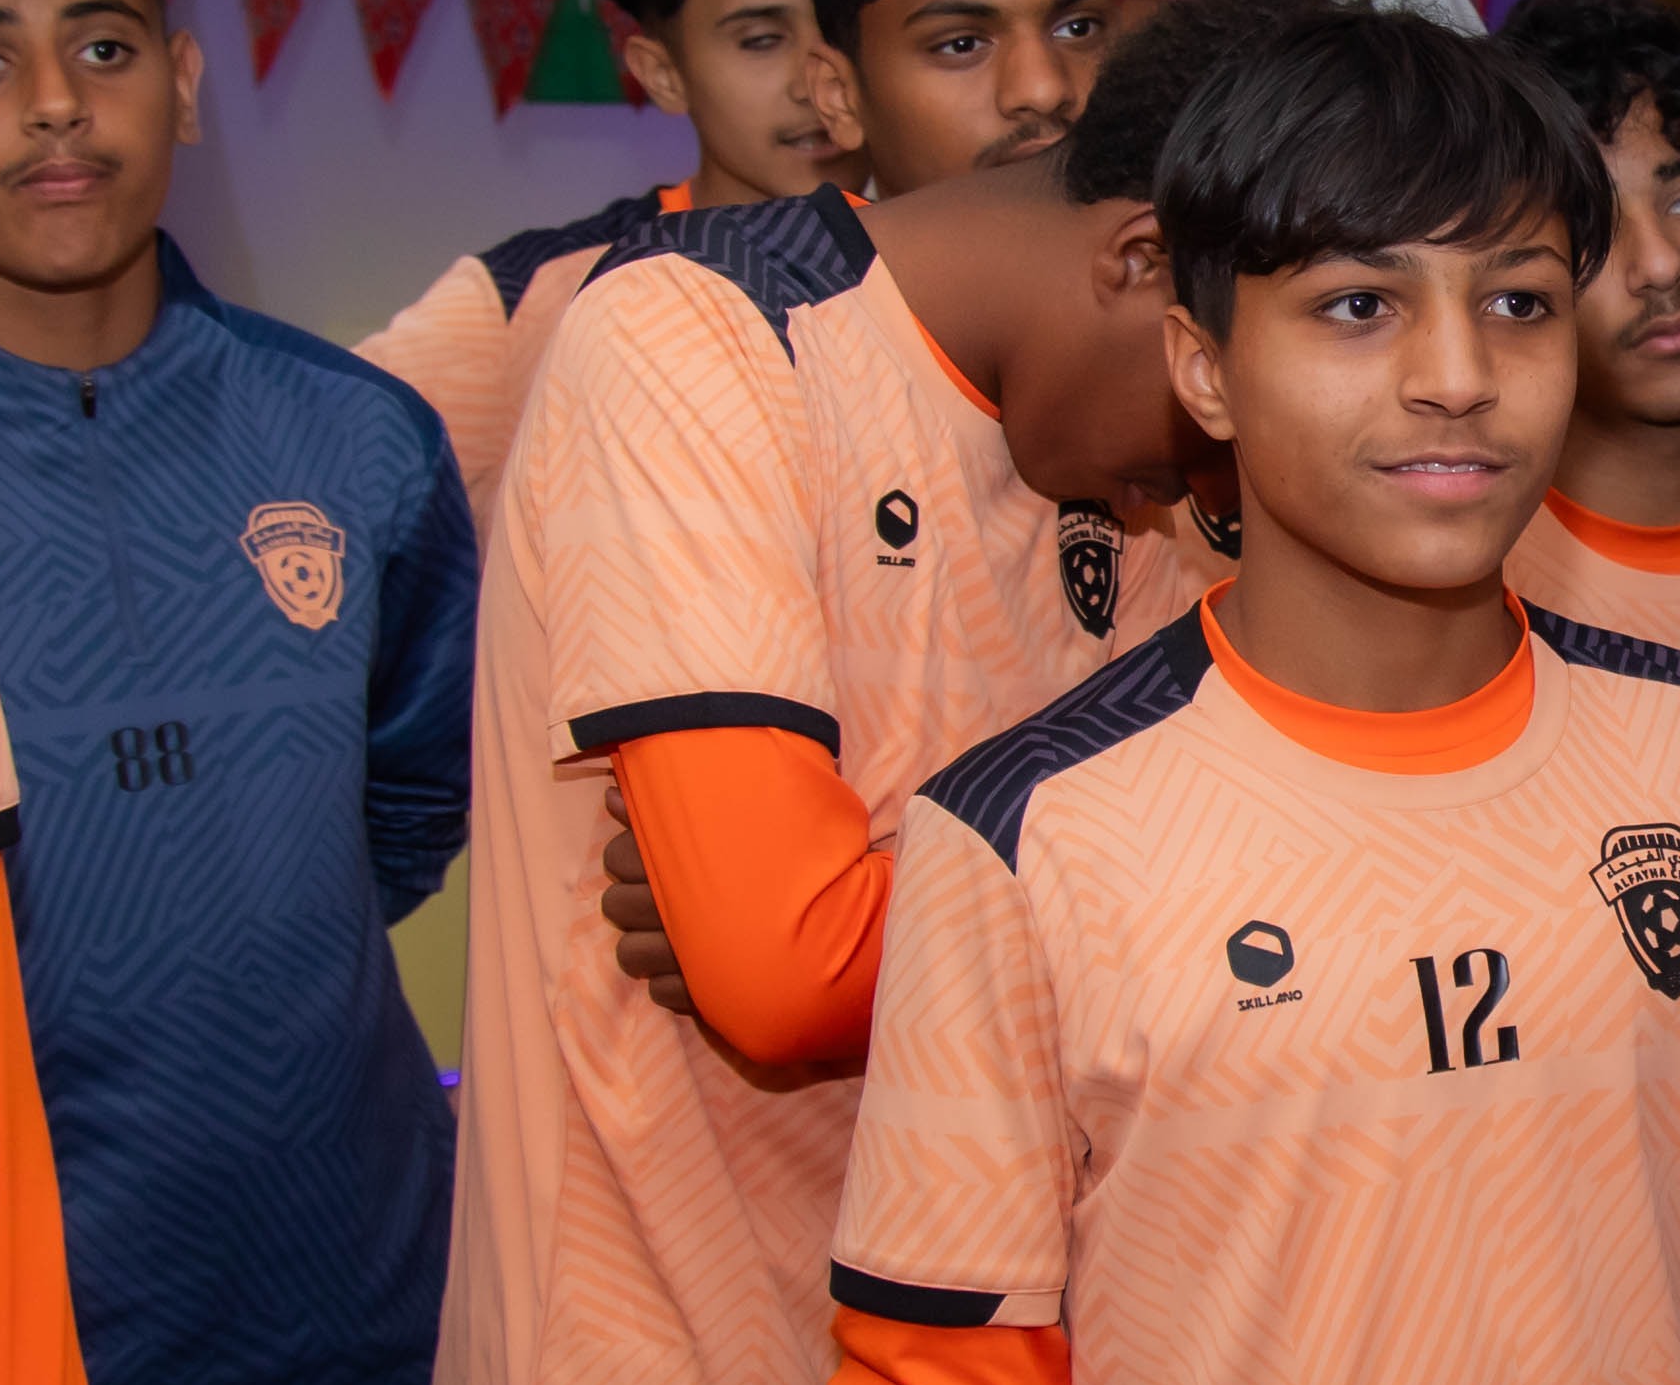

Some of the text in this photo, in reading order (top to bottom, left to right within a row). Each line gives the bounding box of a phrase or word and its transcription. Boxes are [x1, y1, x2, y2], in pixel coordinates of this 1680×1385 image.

[109, 721, 194, 792] 88
[1613, 868, 1667, 893] ALFAYHA
[1409, 948, 1520, 1075] 12
